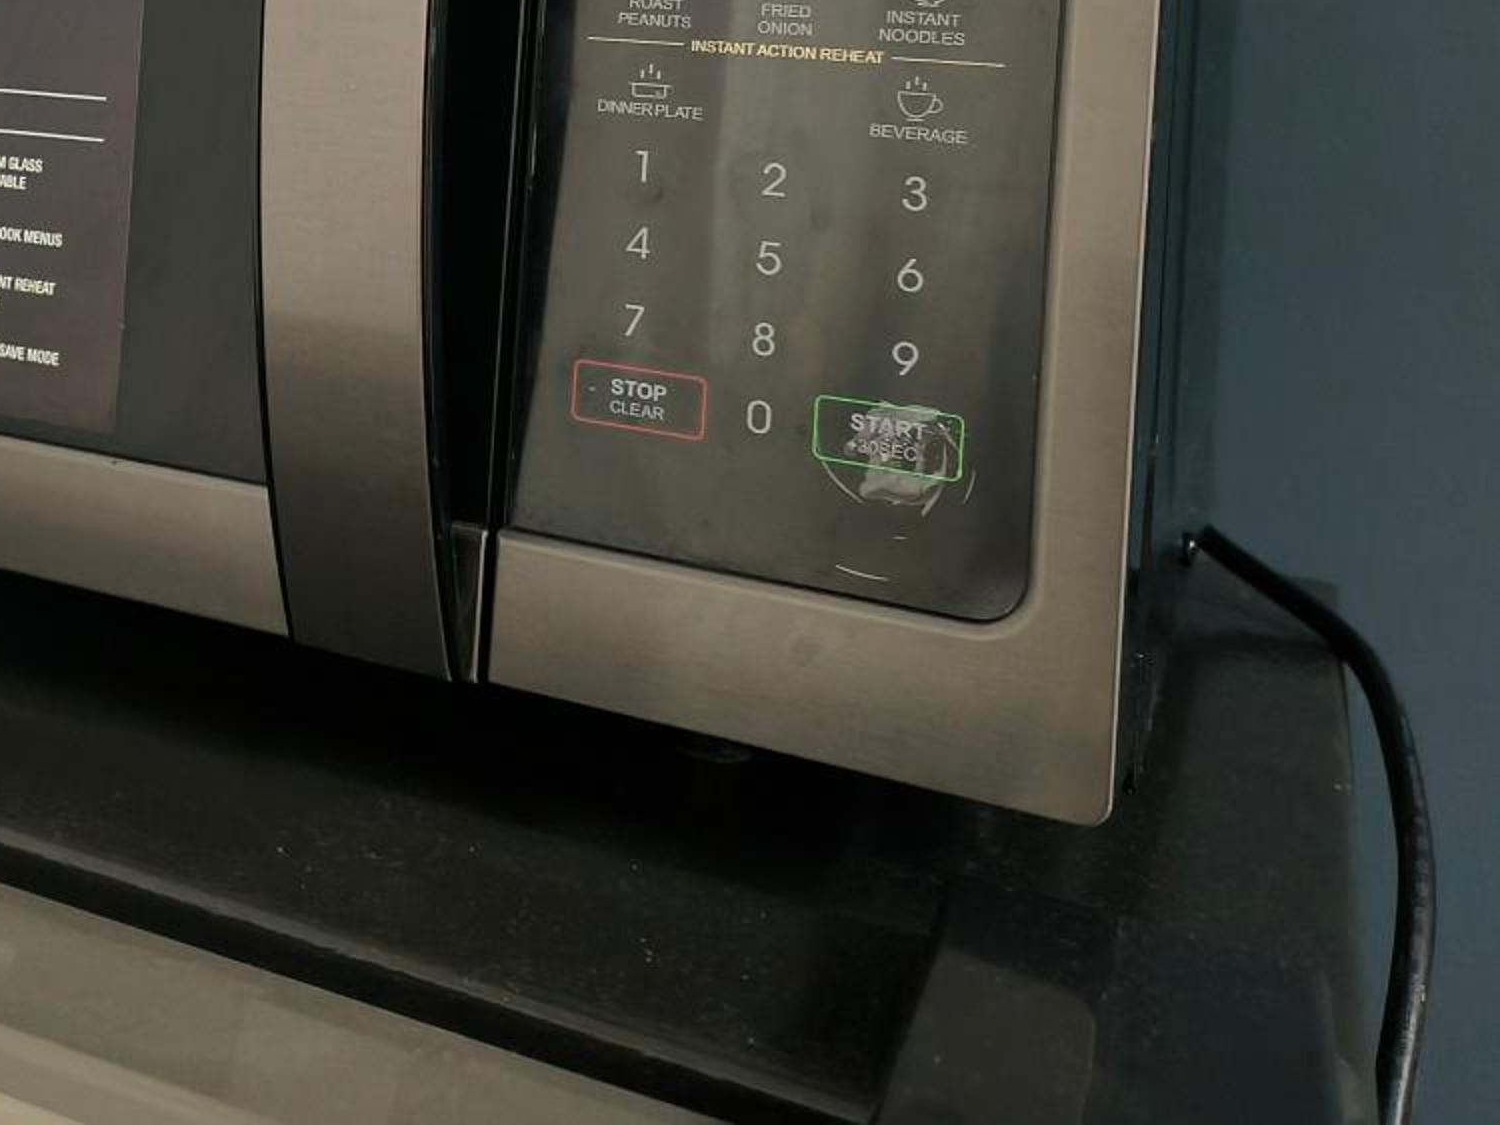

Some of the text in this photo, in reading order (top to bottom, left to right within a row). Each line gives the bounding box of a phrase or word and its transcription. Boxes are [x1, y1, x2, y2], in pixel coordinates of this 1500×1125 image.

[617, 11, 692, 29] PEANUTS
[760, 3, 812, 19] FRIED
[886, 10, 962, 28] INSTANT
[757, 20, 814, 36] ONION
[879, 28, 965, 47] NOODLES
[690, 40, 885, 64] INSTANT ACTION REHEAT
[597, 98, 703, 121] DINNER PLATE
[869, 123, 968, 145] BEVERAGE
[7, 156, 43, 173] GLASS
[636, 150, 651, 183] 1
[761, 163, 787, 198] 2
[902, 176, 928, 212] 3
[23, 229, 63, 247] MENUS
[626, 227, 651, 260] 4
[756, 241, 783, 276] 5
[14, 277, 56, 296] REHEAT
[897, 258, 924, 293] 6
[624, 305, 646, 338] 7
[752, 322, 776, 357] 8
[26, 348, 60, 366] MODE
[892, 341, 919, 375] 9
[610, 378, 667, 402] STOP
[609, 400, 665, 420] CLEAR
[747, 400, 772, 435] 0
[851, 412, 927, 441] START
